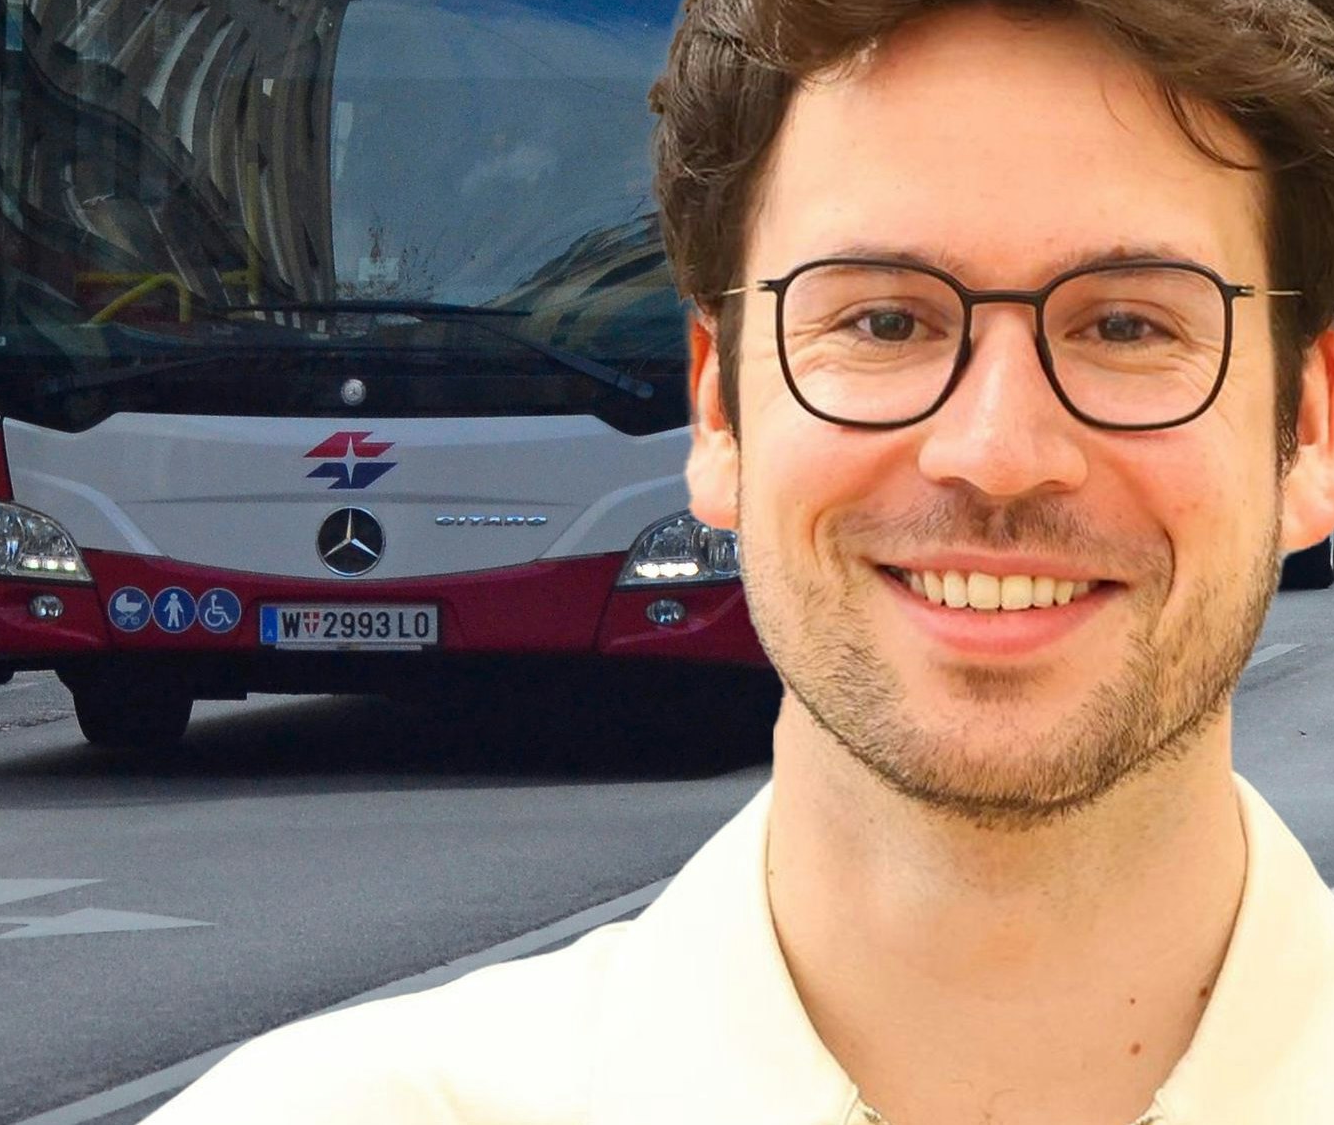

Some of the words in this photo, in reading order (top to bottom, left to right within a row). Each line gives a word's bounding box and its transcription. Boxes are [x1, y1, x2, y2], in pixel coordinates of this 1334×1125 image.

[434, 515, 548, 526] CITARO
[281, 611, 302, 637] W
[323, 611, 391, 638] 2993
